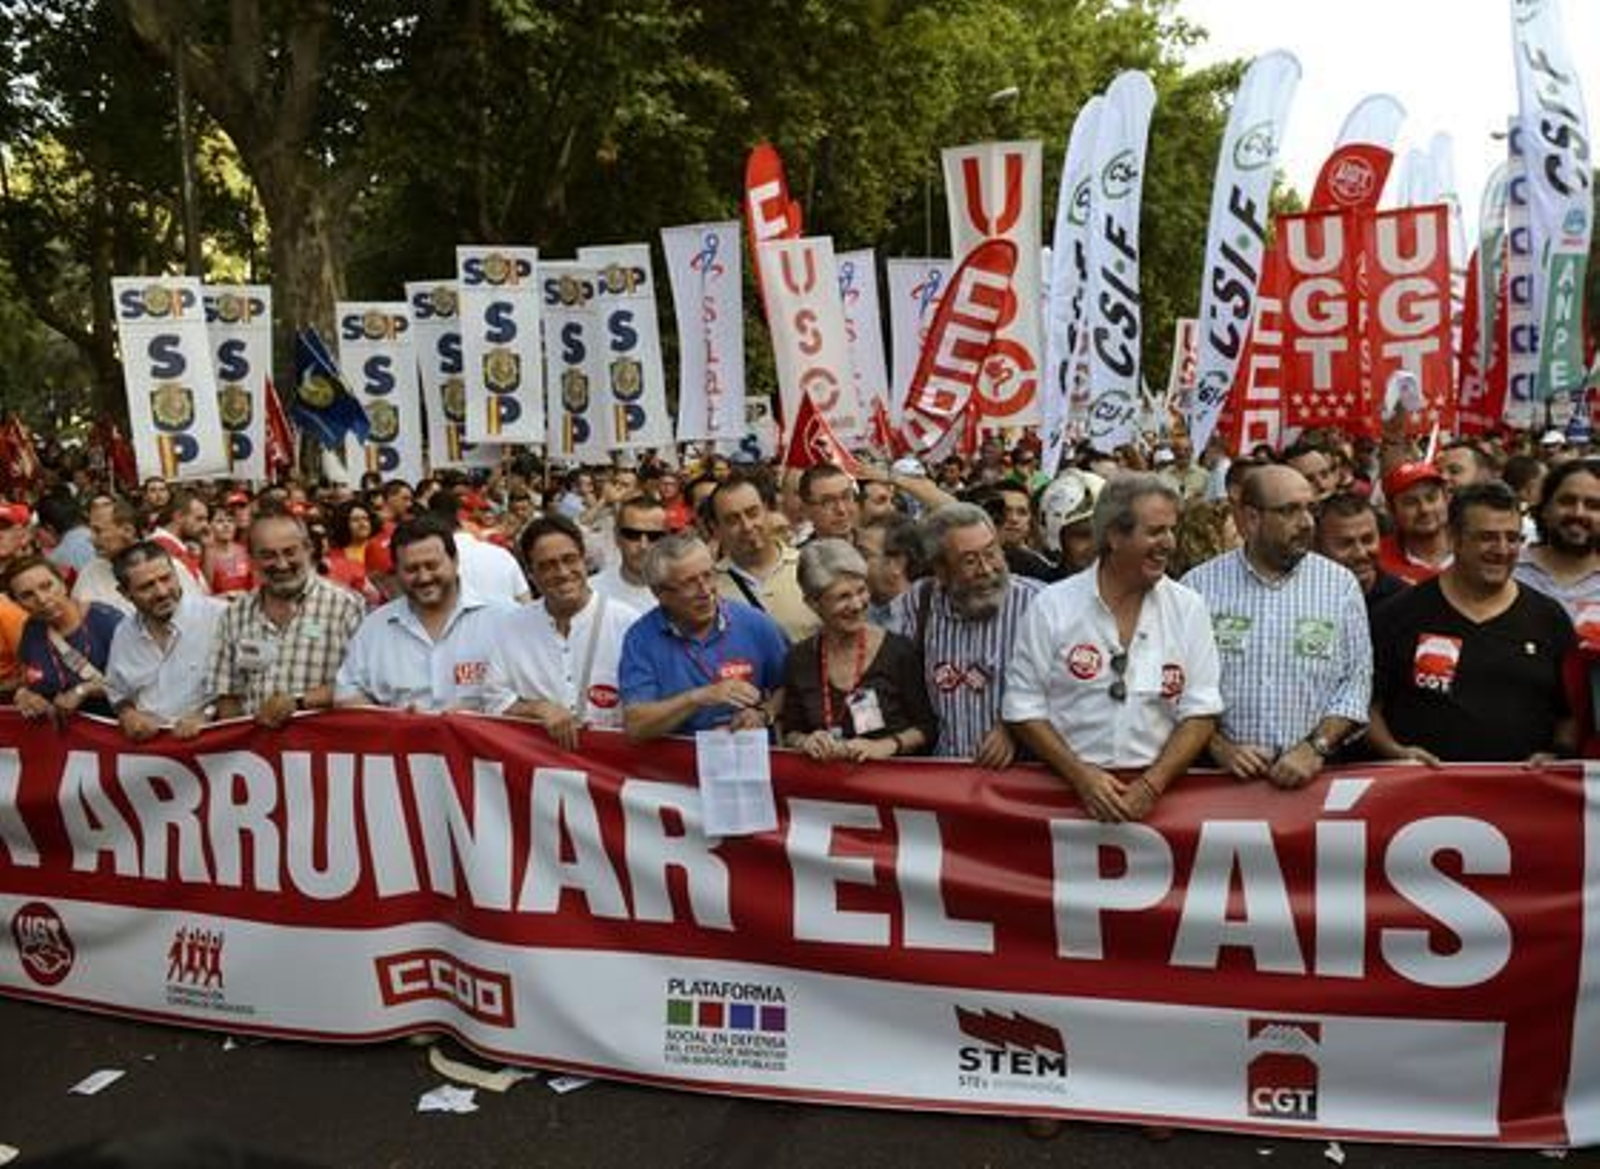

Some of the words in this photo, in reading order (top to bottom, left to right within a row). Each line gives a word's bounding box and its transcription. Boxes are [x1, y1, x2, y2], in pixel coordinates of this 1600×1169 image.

[482, 302, 521, 434] SUP
[780, 247, 840, 411] USO
[1286, 216, 1348, 390] UGT
[1376, 213, 1441, 402] UGT
[1551, 261, 1575, 390] ANPE
[147, 334, 200, 478] SUP
[560, 322, 591, 454] SUP
[607, 309, 647, 442] SUP
[1415, 673, 1452, 693] CGT
[58, 749, 735, 932] ARRUINAR
[786, 799, 995, 953] EL
[1050, 778, 1513, 989] PAÍS
[387, 958, 505, 1017] CCOO
[666, 1030, 707, 1043] SOCIAL
[712, 1033, 728, 1044] EN
[731, 1034, 786, 1048] DEFENSA
[668, 980, 785, 1002] PLATAFORMA
[958, 1046, 1067, 1077] STEM
[1252, 1086, 1314, 1112] CGT
